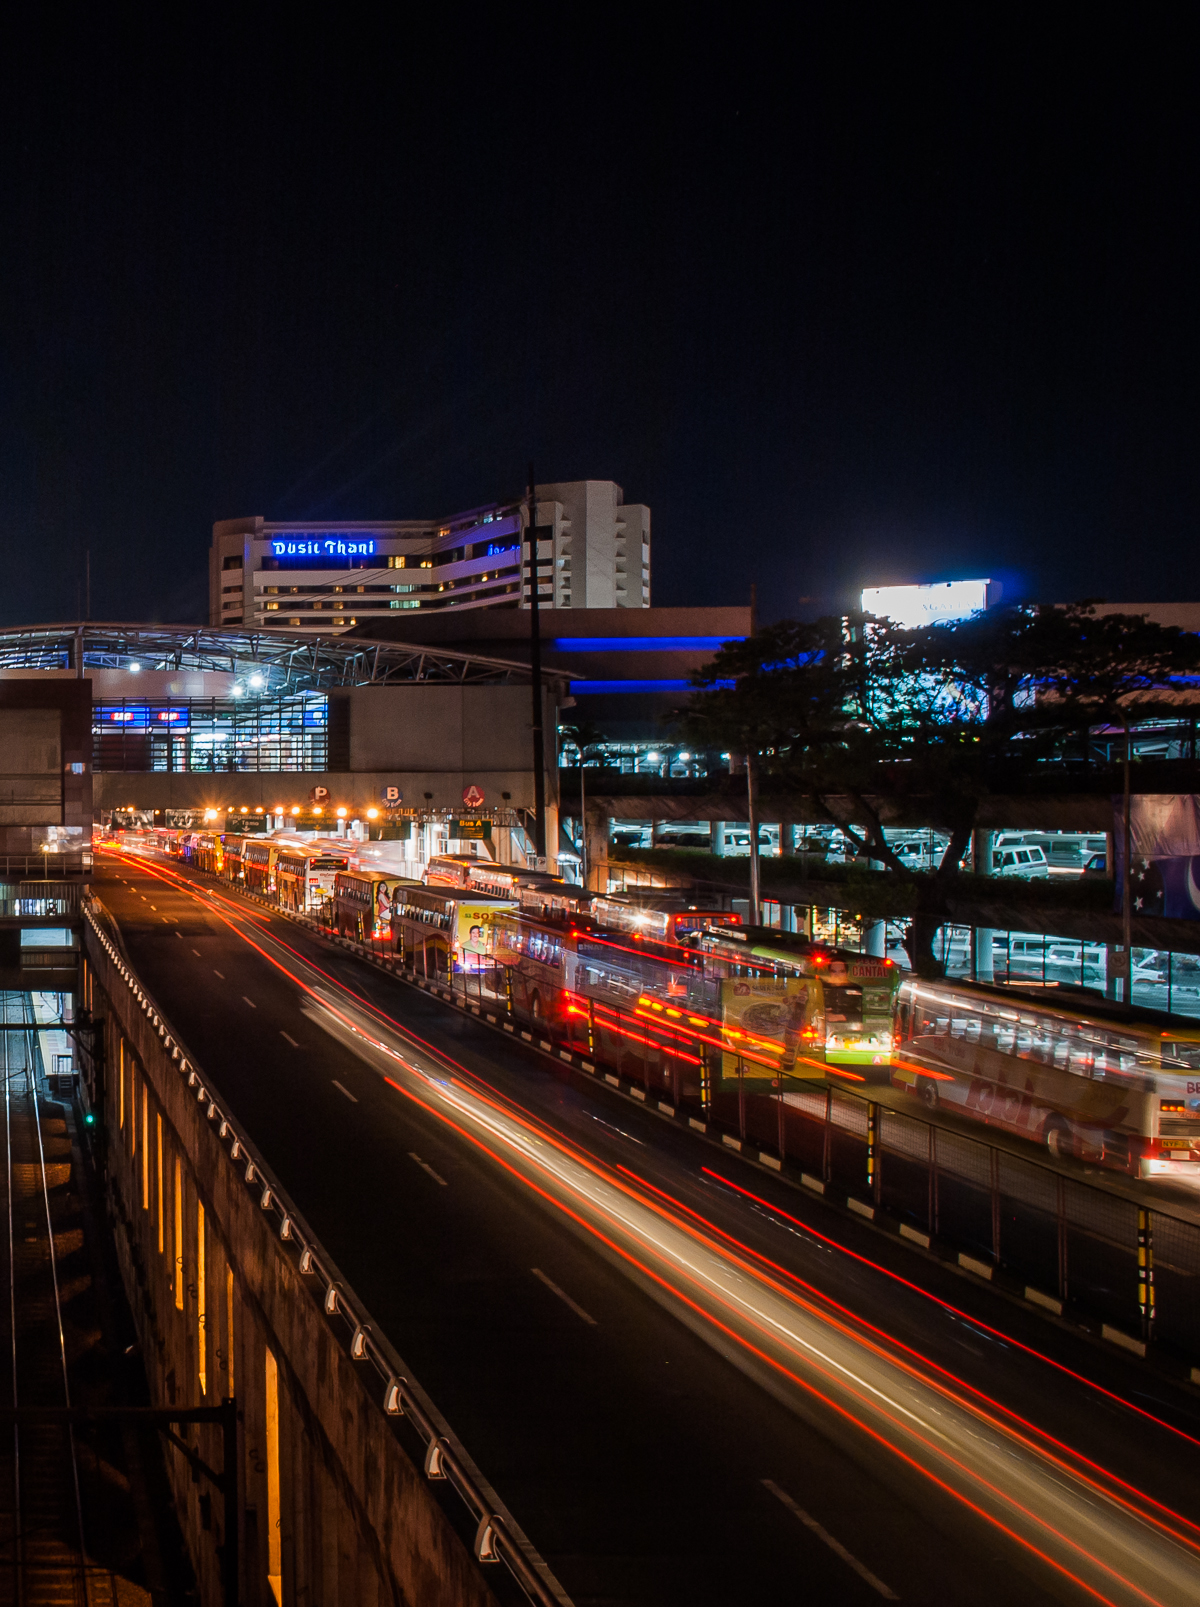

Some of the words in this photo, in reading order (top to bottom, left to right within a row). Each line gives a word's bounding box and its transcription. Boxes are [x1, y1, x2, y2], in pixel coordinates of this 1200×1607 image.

[272, 541, 320, 554] Dusit
[325, 540, 374, 555] Thani
[315, 786, 328, 800] P
[387, 786, 399, 800] B
[467, 785, 480, 798] A
[852, 965, 888, 977] CANTAL
[873, 1055, 882, 1064] A
